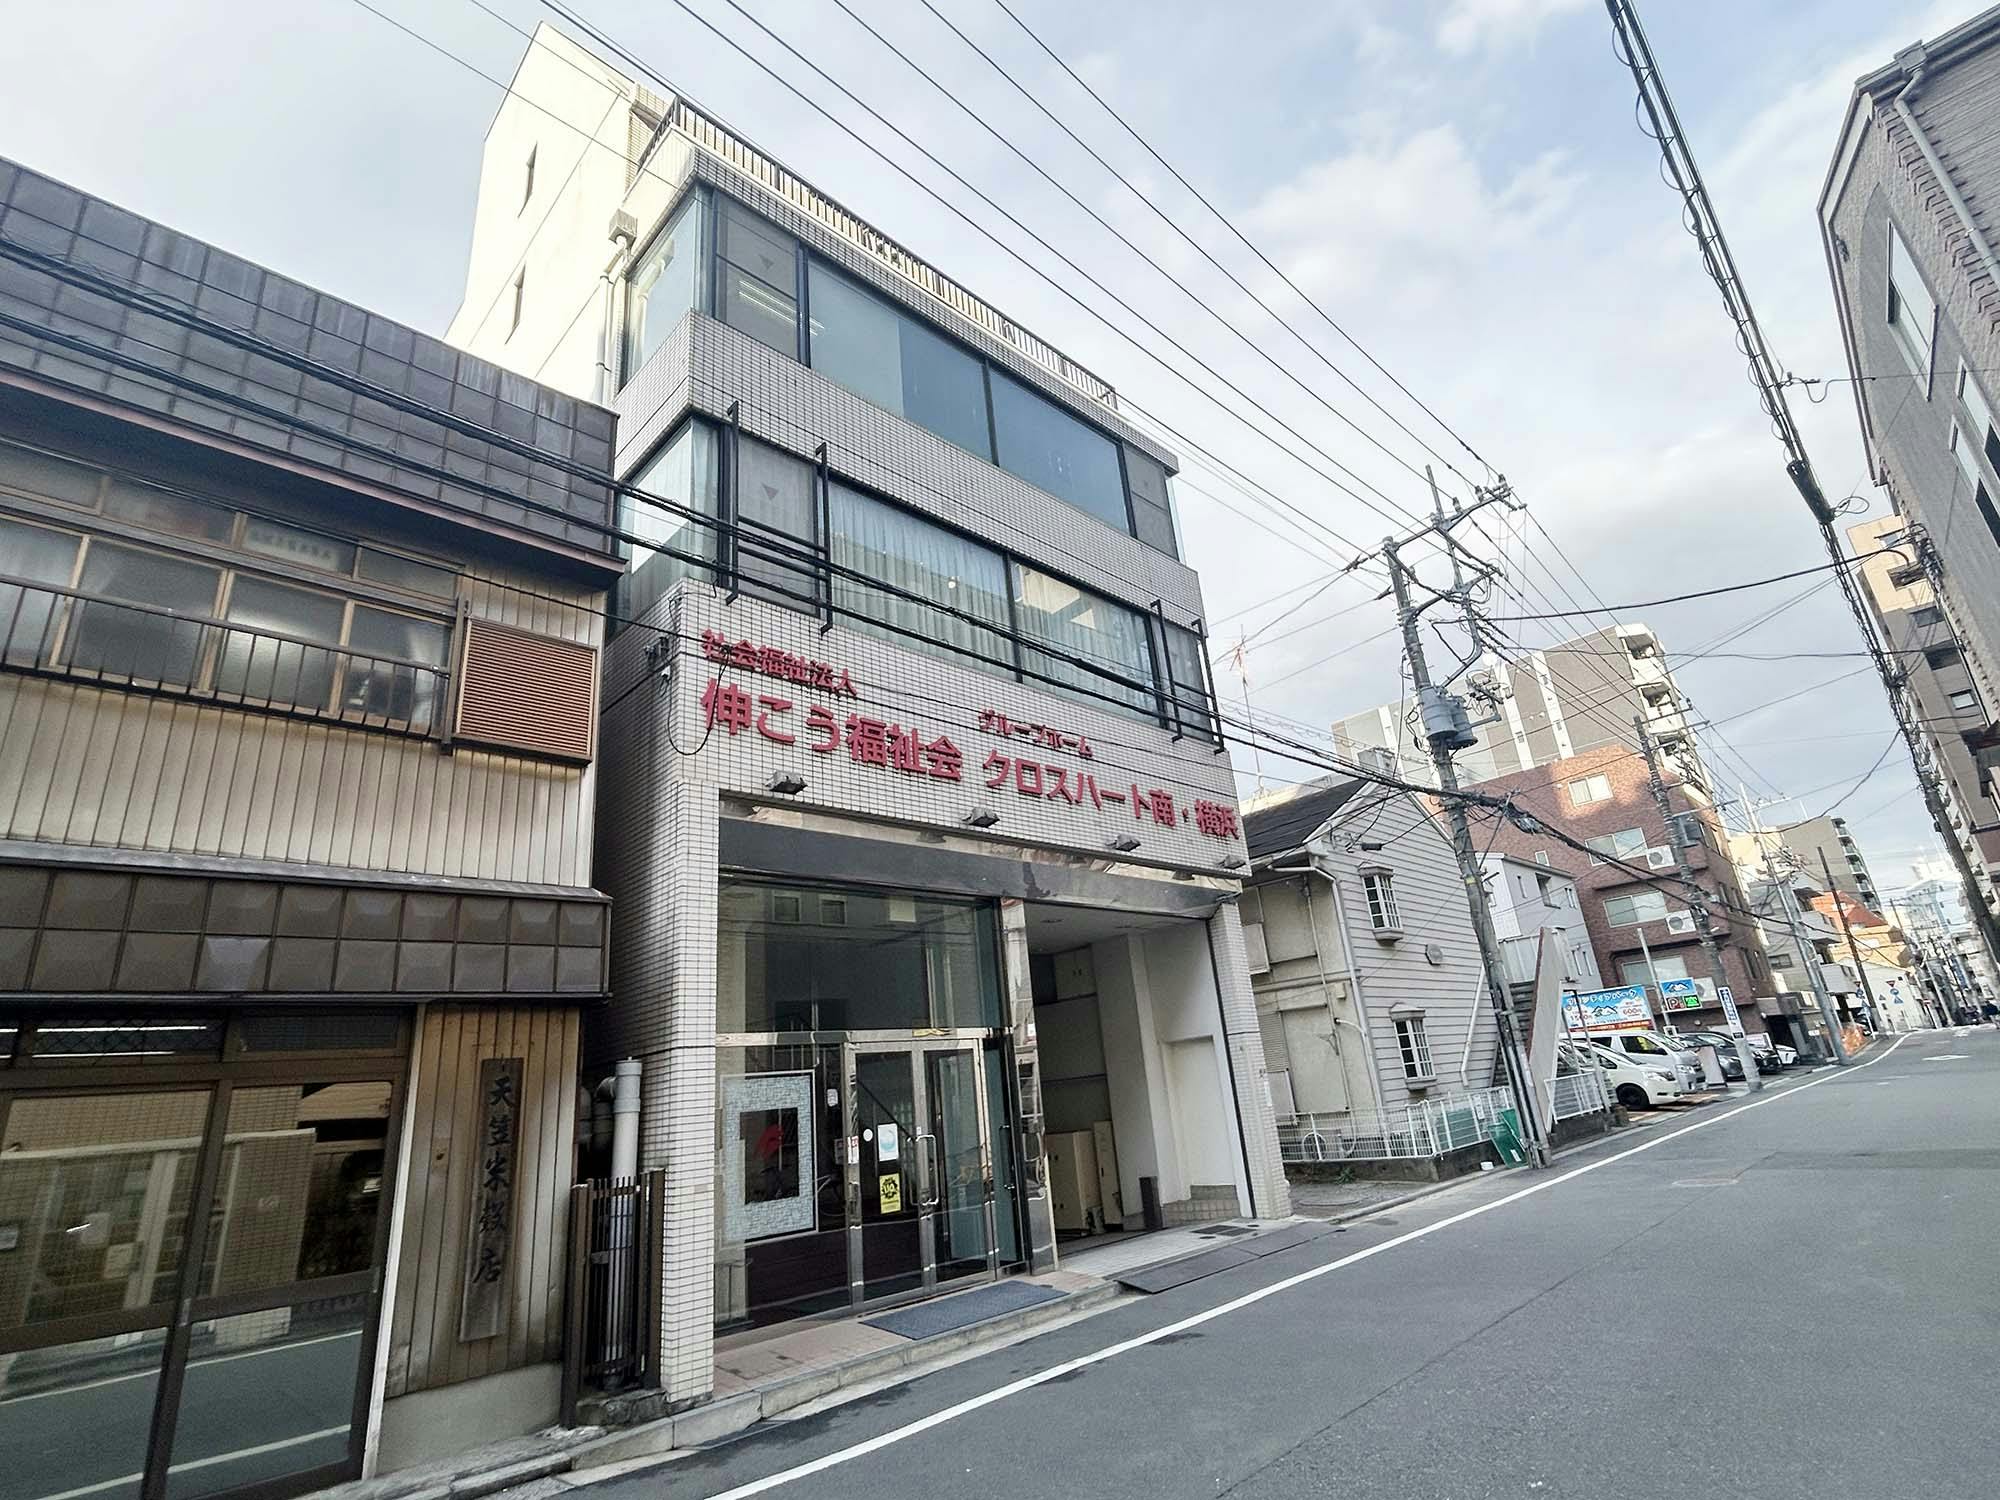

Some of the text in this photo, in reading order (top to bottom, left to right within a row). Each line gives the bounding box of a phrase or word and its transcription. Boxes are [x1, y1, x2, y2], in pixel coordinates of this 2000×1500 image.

[701, 628, 857, 697] 社会福祉法人
[701, 677, 963, 781] 伸こう福祉会
[978, 708, 1093, 757] グループホーム
[983, 748, 1239, 840] クロスハート南・横浜
